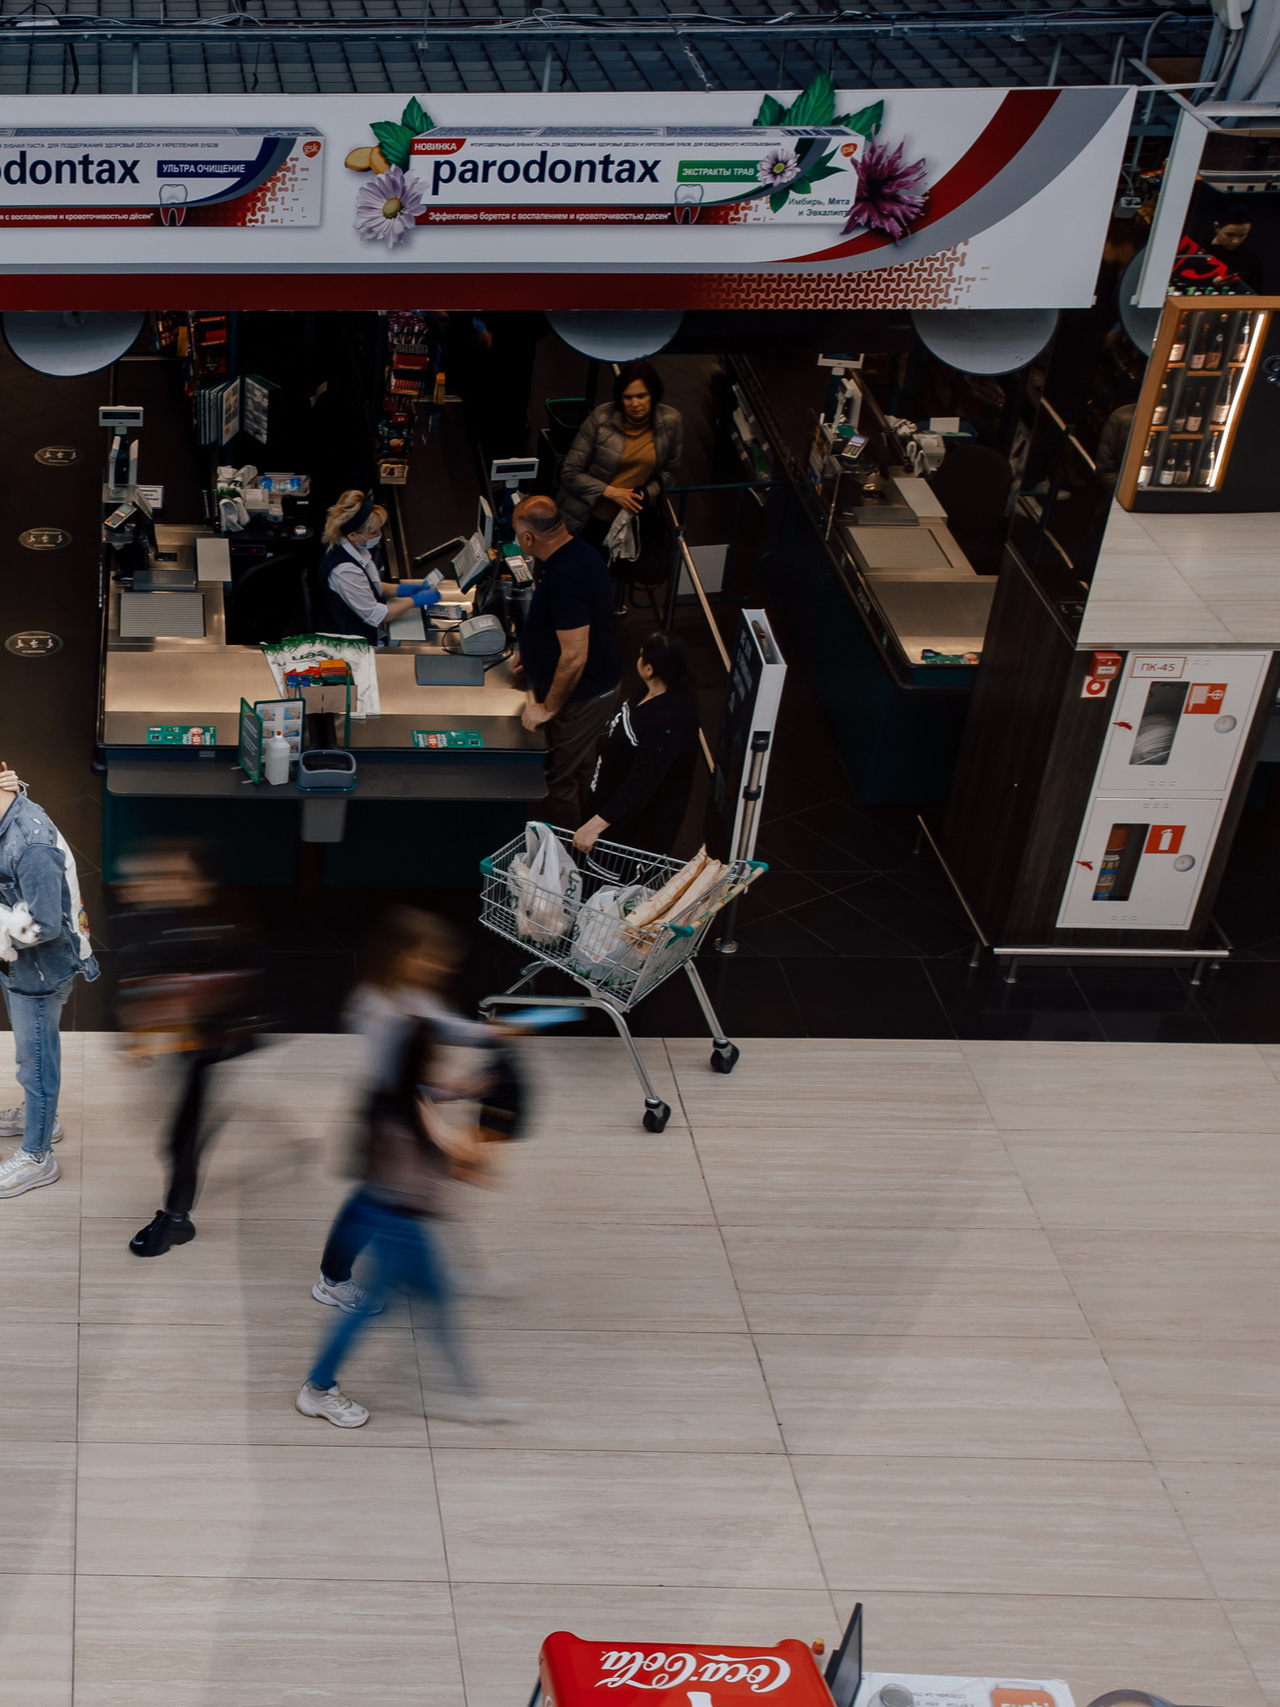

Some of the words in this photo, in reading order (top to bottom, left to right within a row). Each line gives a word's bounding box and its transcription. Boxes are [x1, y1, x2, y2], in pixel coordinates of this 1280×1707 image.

[414, 142, 458, 151] НОВИНКА
[162, 164, 196, 173] УЛЬТРА
[196, 163, 246, 174] ОЧИЩЕНИЕ
[431, 150, 662, 196] parodontax
[682, 168, 732, 176] ЭКСТРАКТЫ
[733, 168, 755, 176] ТРАВ
[788, 197, 826, 207] Имбирь,
[828, 197, 850, 206] Мята
[65, 213, 129, 221] кровоточивостью
[429, 212, 478, 221] Эффективно
[479, 212, 511, 220] борется
[576, 212, 644, 221] кровоточивостью
[1140, 663, 1176, 672] ПК-45
[594, 1650, 791, 1694] Coca-Cola
